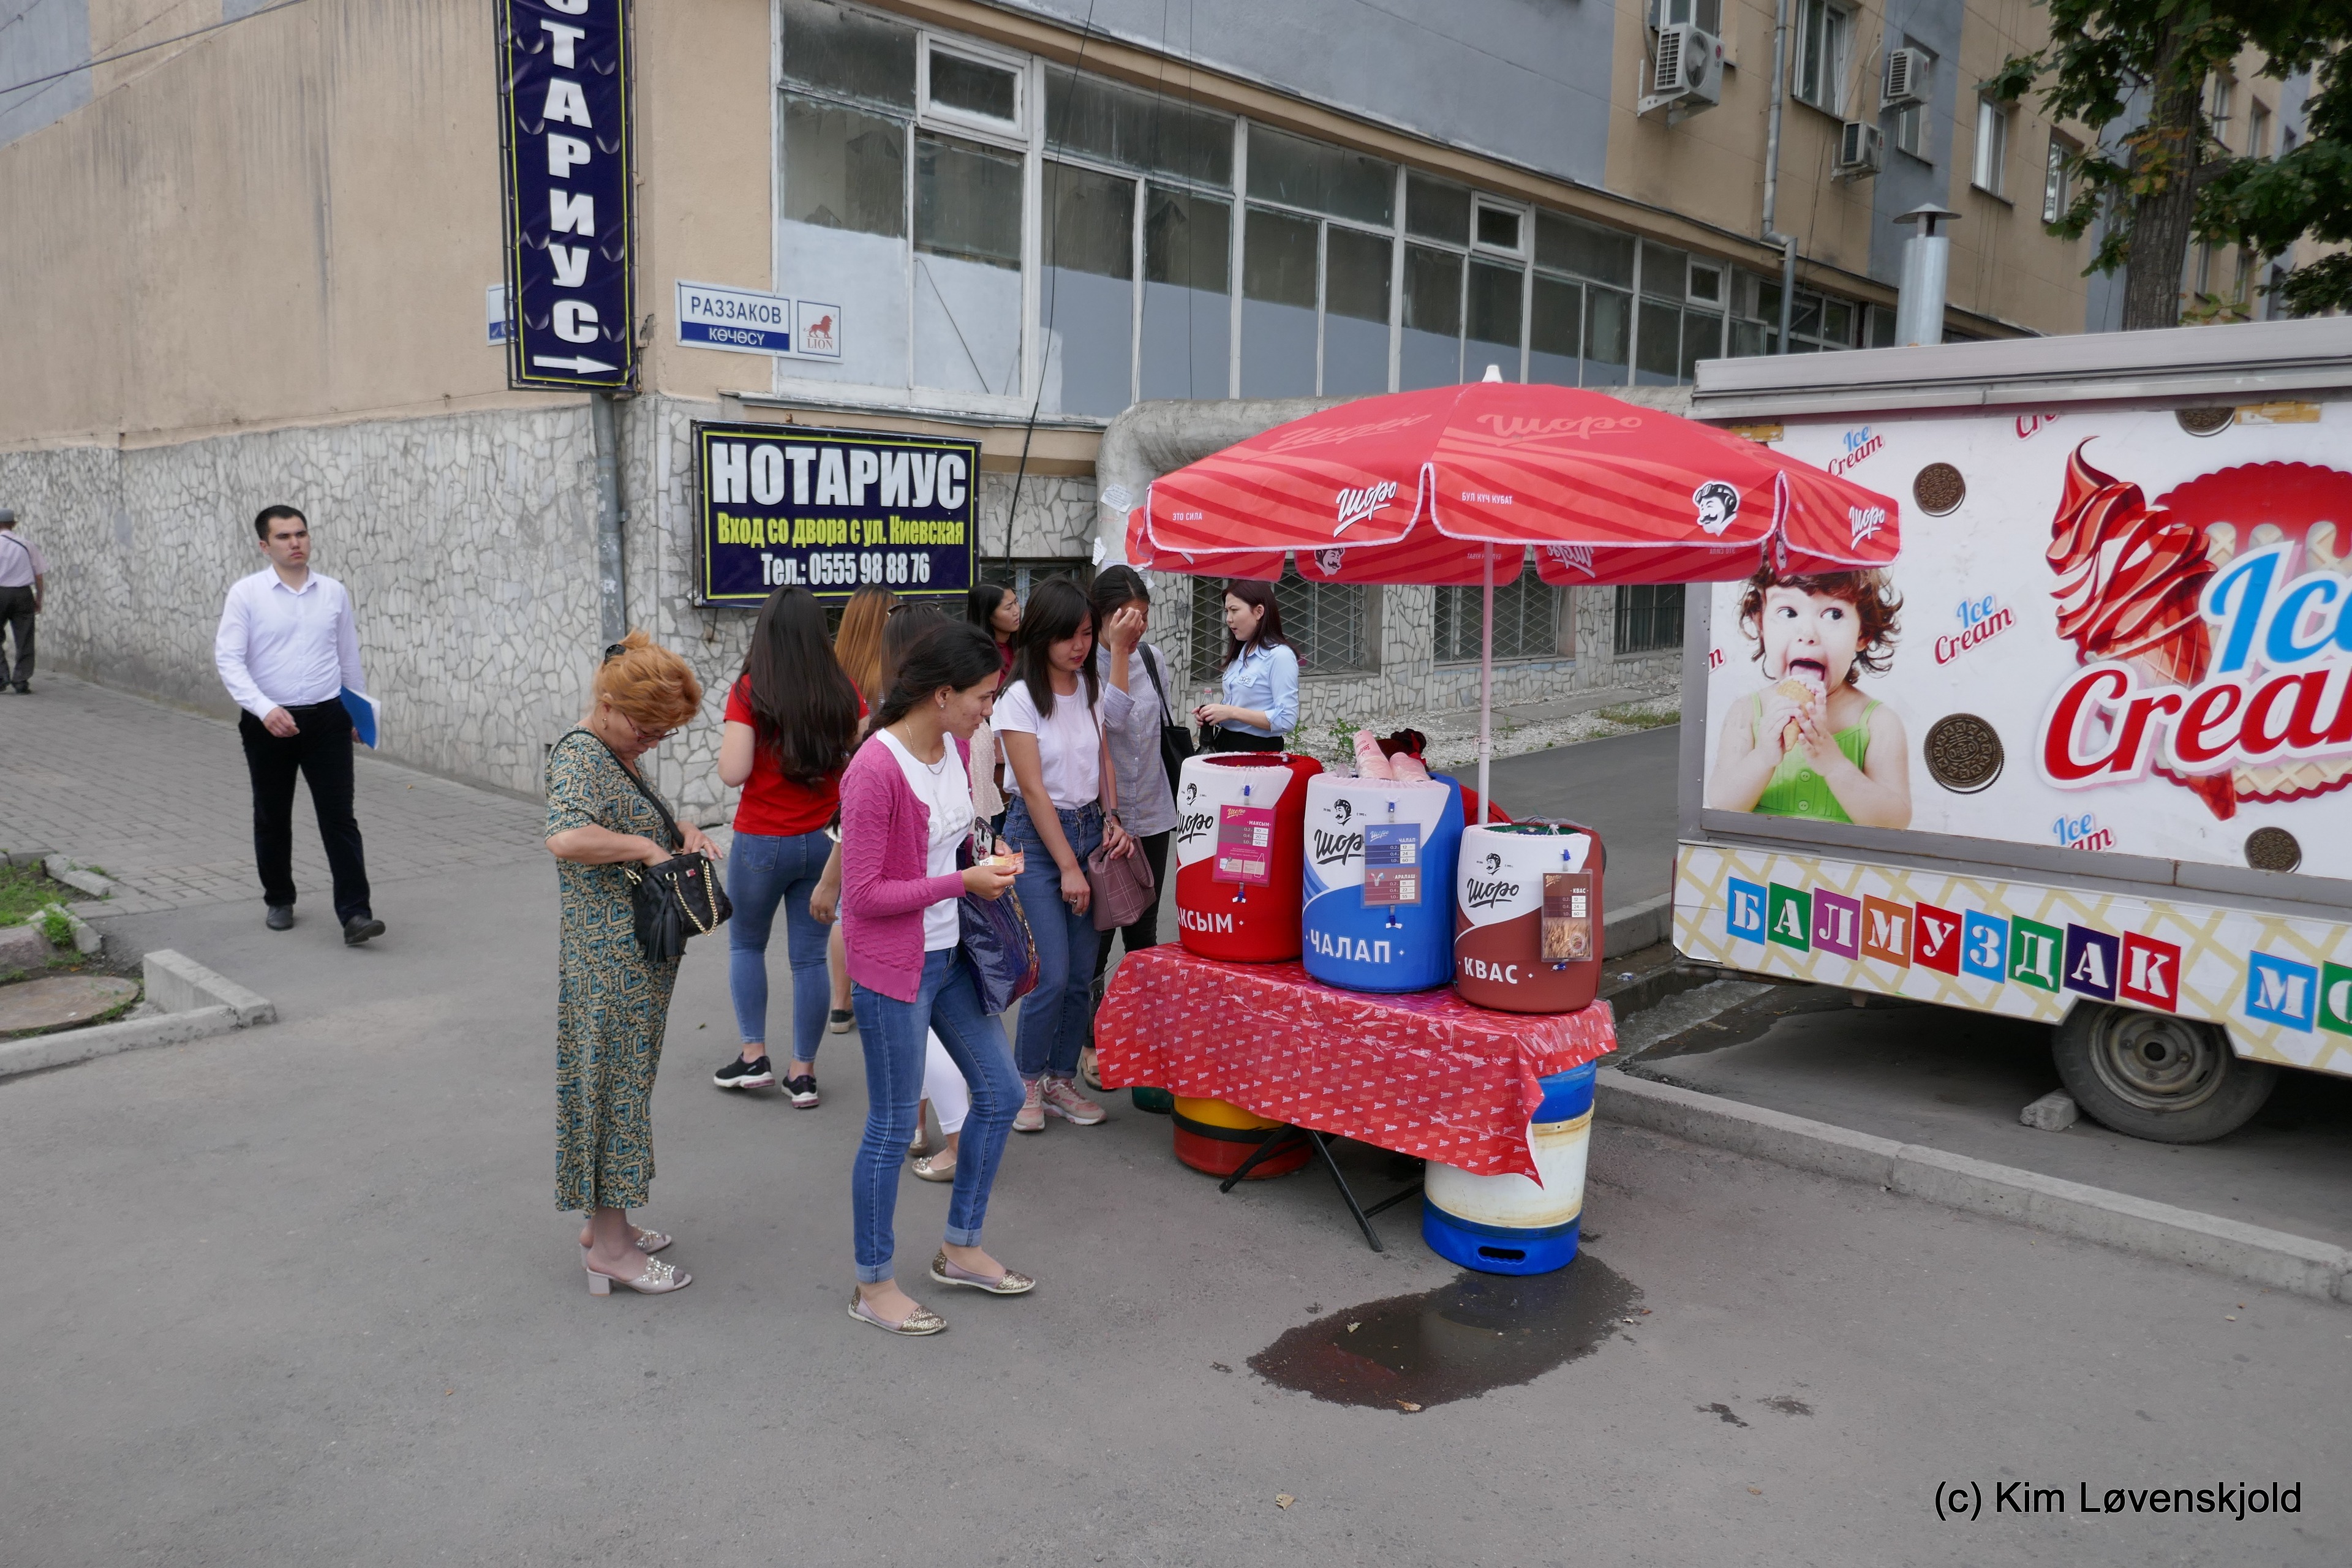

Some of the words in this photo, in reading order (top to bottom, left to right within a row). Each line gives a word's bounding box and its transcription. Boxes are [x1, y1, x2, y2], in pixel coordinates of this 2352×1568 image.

[691, 296, 782, 324] РАЗЗАКОВ
[709, 327, 765, 346] КӨЧӨСҮ
[807, 337, 833, 350] LION
[1843, 426, 1869, 452] Ice
[712, 442, 967, 510] НОТАРИУС
[1461, 492, 1475, 502] БУЛ
[1491, 495, 1513, 505] КУБАТ
[717, 511, 765, 548] Вход
[767, 518, 790, 545] со
[792, 518, 847, 548] двора
[850, 520, 861, 544] с
[862, 520, 887, 547] ул.
[889, 515, 965, 545] Киевская
[1172, 513, 1184, 521] ЭТО
[1186, 512, 1202, 521] СИЛА
[761, 553, 806, 586] Тел.:
[809, 553, 857, 586] 0555
[859, 553, 883, 585] 98
[885, 553, 908, 584] 88
[910, 553, 930, 584] 76
[1956, 595, 1993, 628] Ice
[1934, 608, 2012, 665] Cream
[2052, 814, 2092, 845] Ice
[1314, 829, 1365, 865] Шор
[1310, 929, 1390, 963] ЧАЛАП
[1732, 889, 2171, 999] БАЛМУЗДАК
[1464, 956, 1518, 984] КВАС
